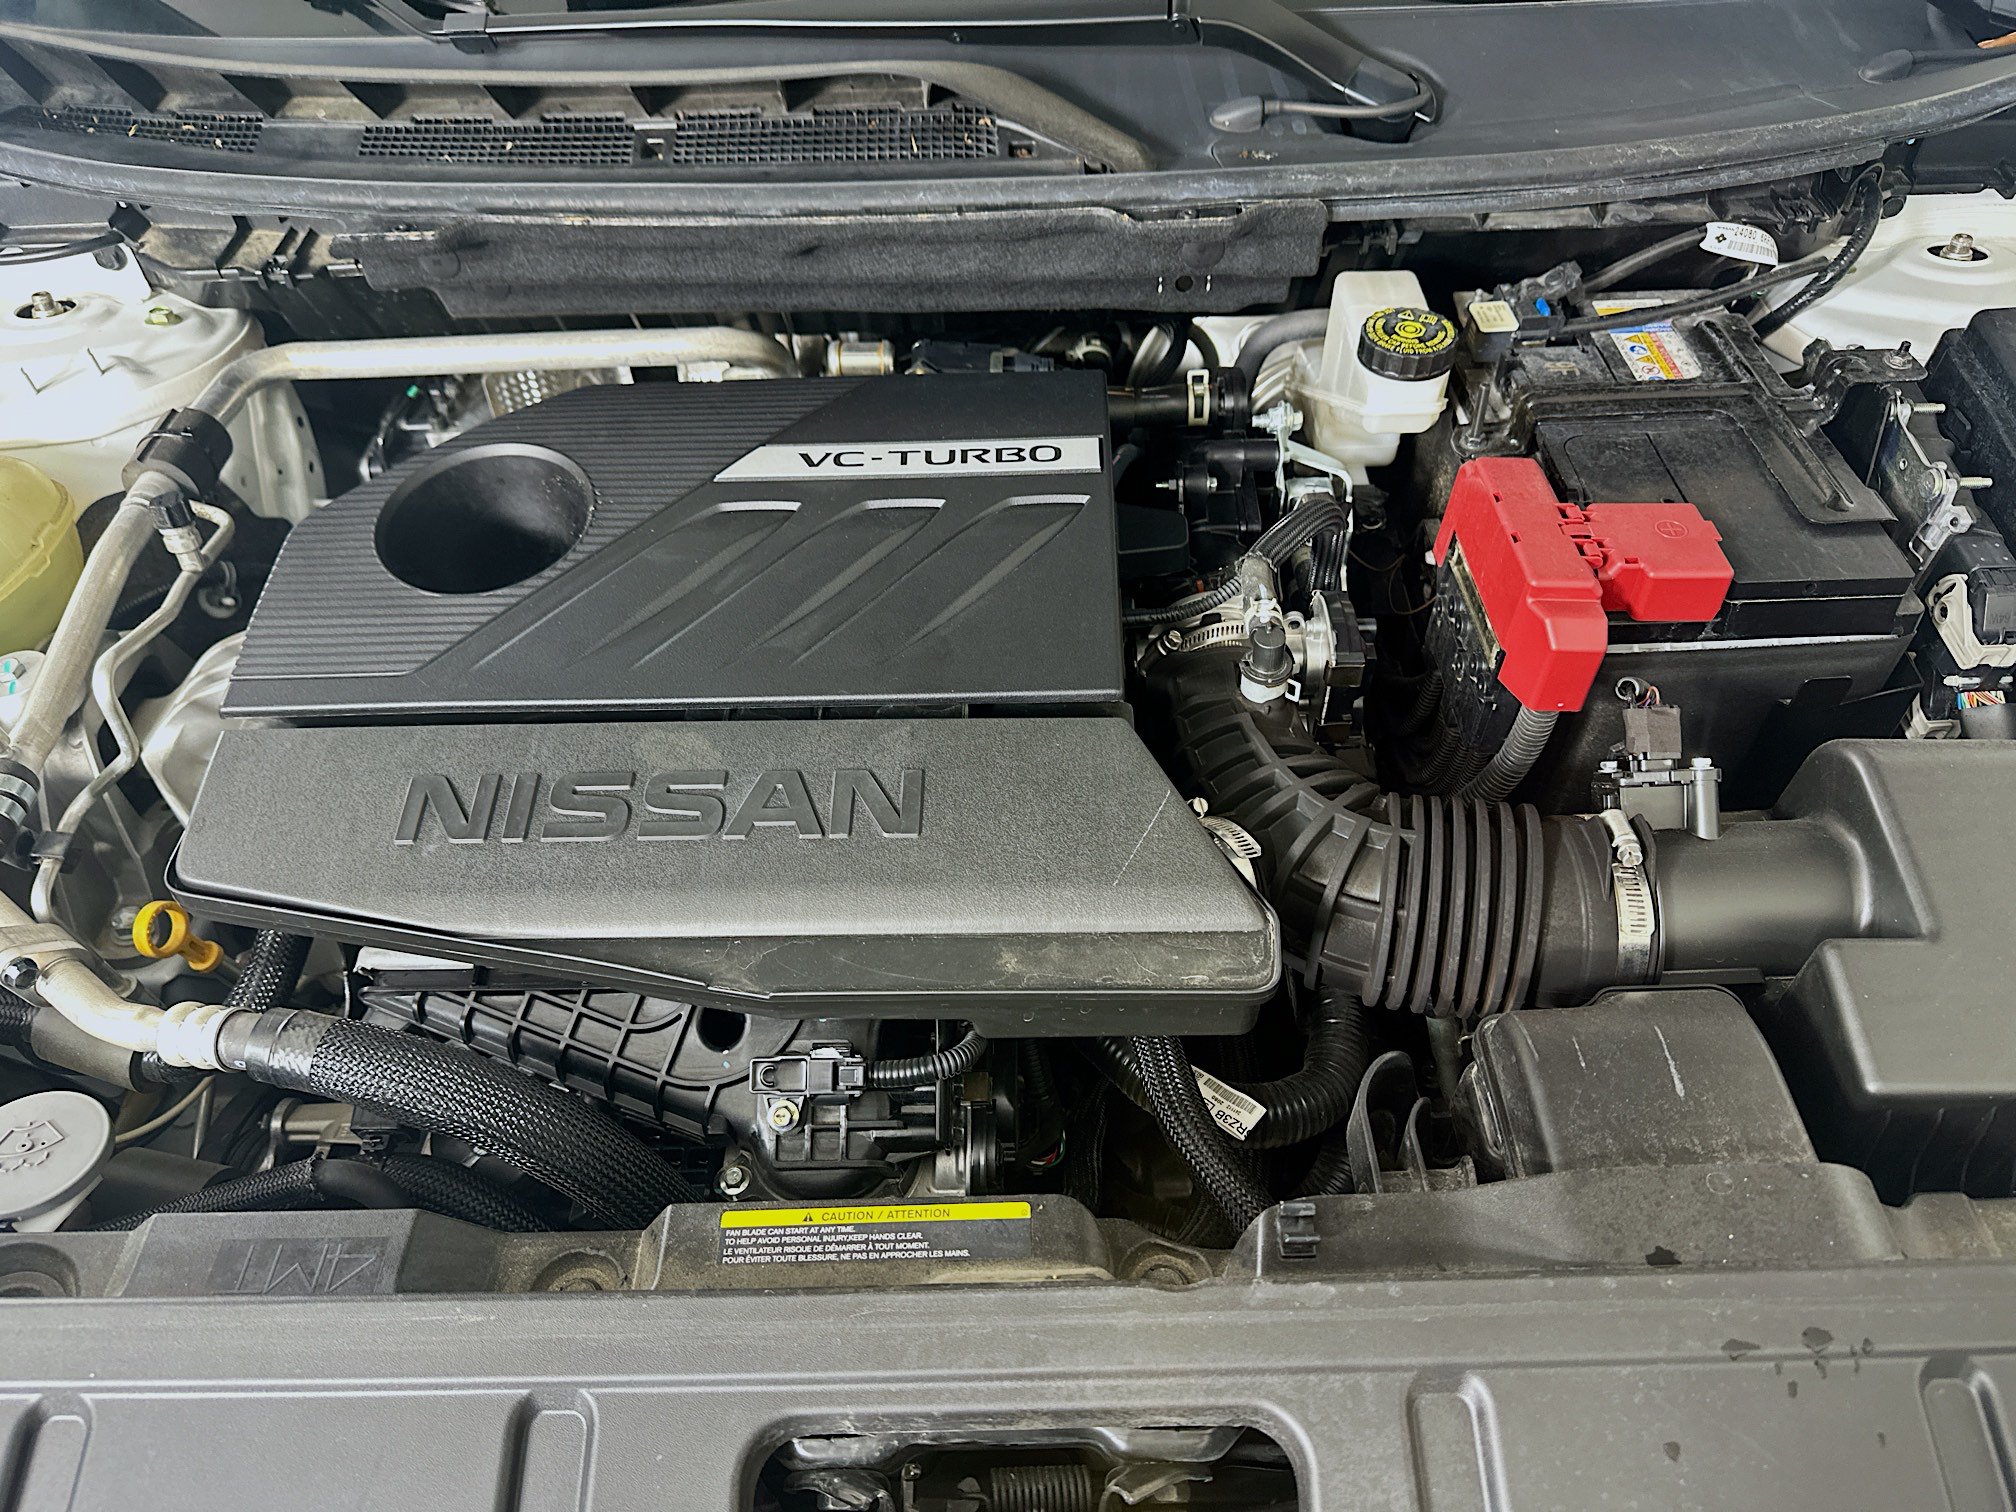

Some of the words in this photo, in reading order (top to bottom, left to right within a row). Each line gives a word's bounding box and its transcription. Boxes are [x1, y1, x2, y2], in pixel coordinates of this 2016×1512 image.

[798, 445, 1062, 468] VC-TURBO
[394, 769, 924, 845] NISSAN
[821, 1211, 874, 1222] CAUTION
[887, 1208, 951, 1219] ATTENTION
[725, 1229, 741, 1237] FAN
[742, 1228, 767, 1236] BLADE
[767, 1227, 785, 1235] CAN
[785, 1226, 809, 1235] START
[809, 1226, 819, 1234] AT
[820, 1225, 836, 1233] ANY
[836, 1225, 856, 1233] TIME.
[725, 1238, 735, 1246] TO
[736, 1237, 757, 1245] HELP
[757, 1236, 781, 1244] AVOID
[781, 1235, 821, 1244] PERSONAL
[869, 1232, 896, 1241] HANDS
[896, 1232, 923, 1240] CLEAR.
[734, 1246, 782, 1255] VENTILATEUR
[783, 1245, 812, 1254] RISQUE
[813, 1245, 824, 1253] DE
[825, 1242, 867, 1252] DÉMARRER
[867, 1240, 873, 1250] À
[895, 1241, 930, 1250] MOMENT.
[722, 1256, 745, 1264] POUR
[745, 1254, 771, 1263] ÉVITER
[772, 1254, 797, 1262] TOUTE
[798, 1253, 839, 1262] BLESSURE,
[840, 1252, 851, 1260] NE
[852, 1252, 868, 1260] PAS
[868, 1251, 879, 1259] EN
[880, 1250, 928, 1259] APPROCHER
[929, 1250, 943, 1258] LES
[944, 1249, 970, 1257] MAINS.
